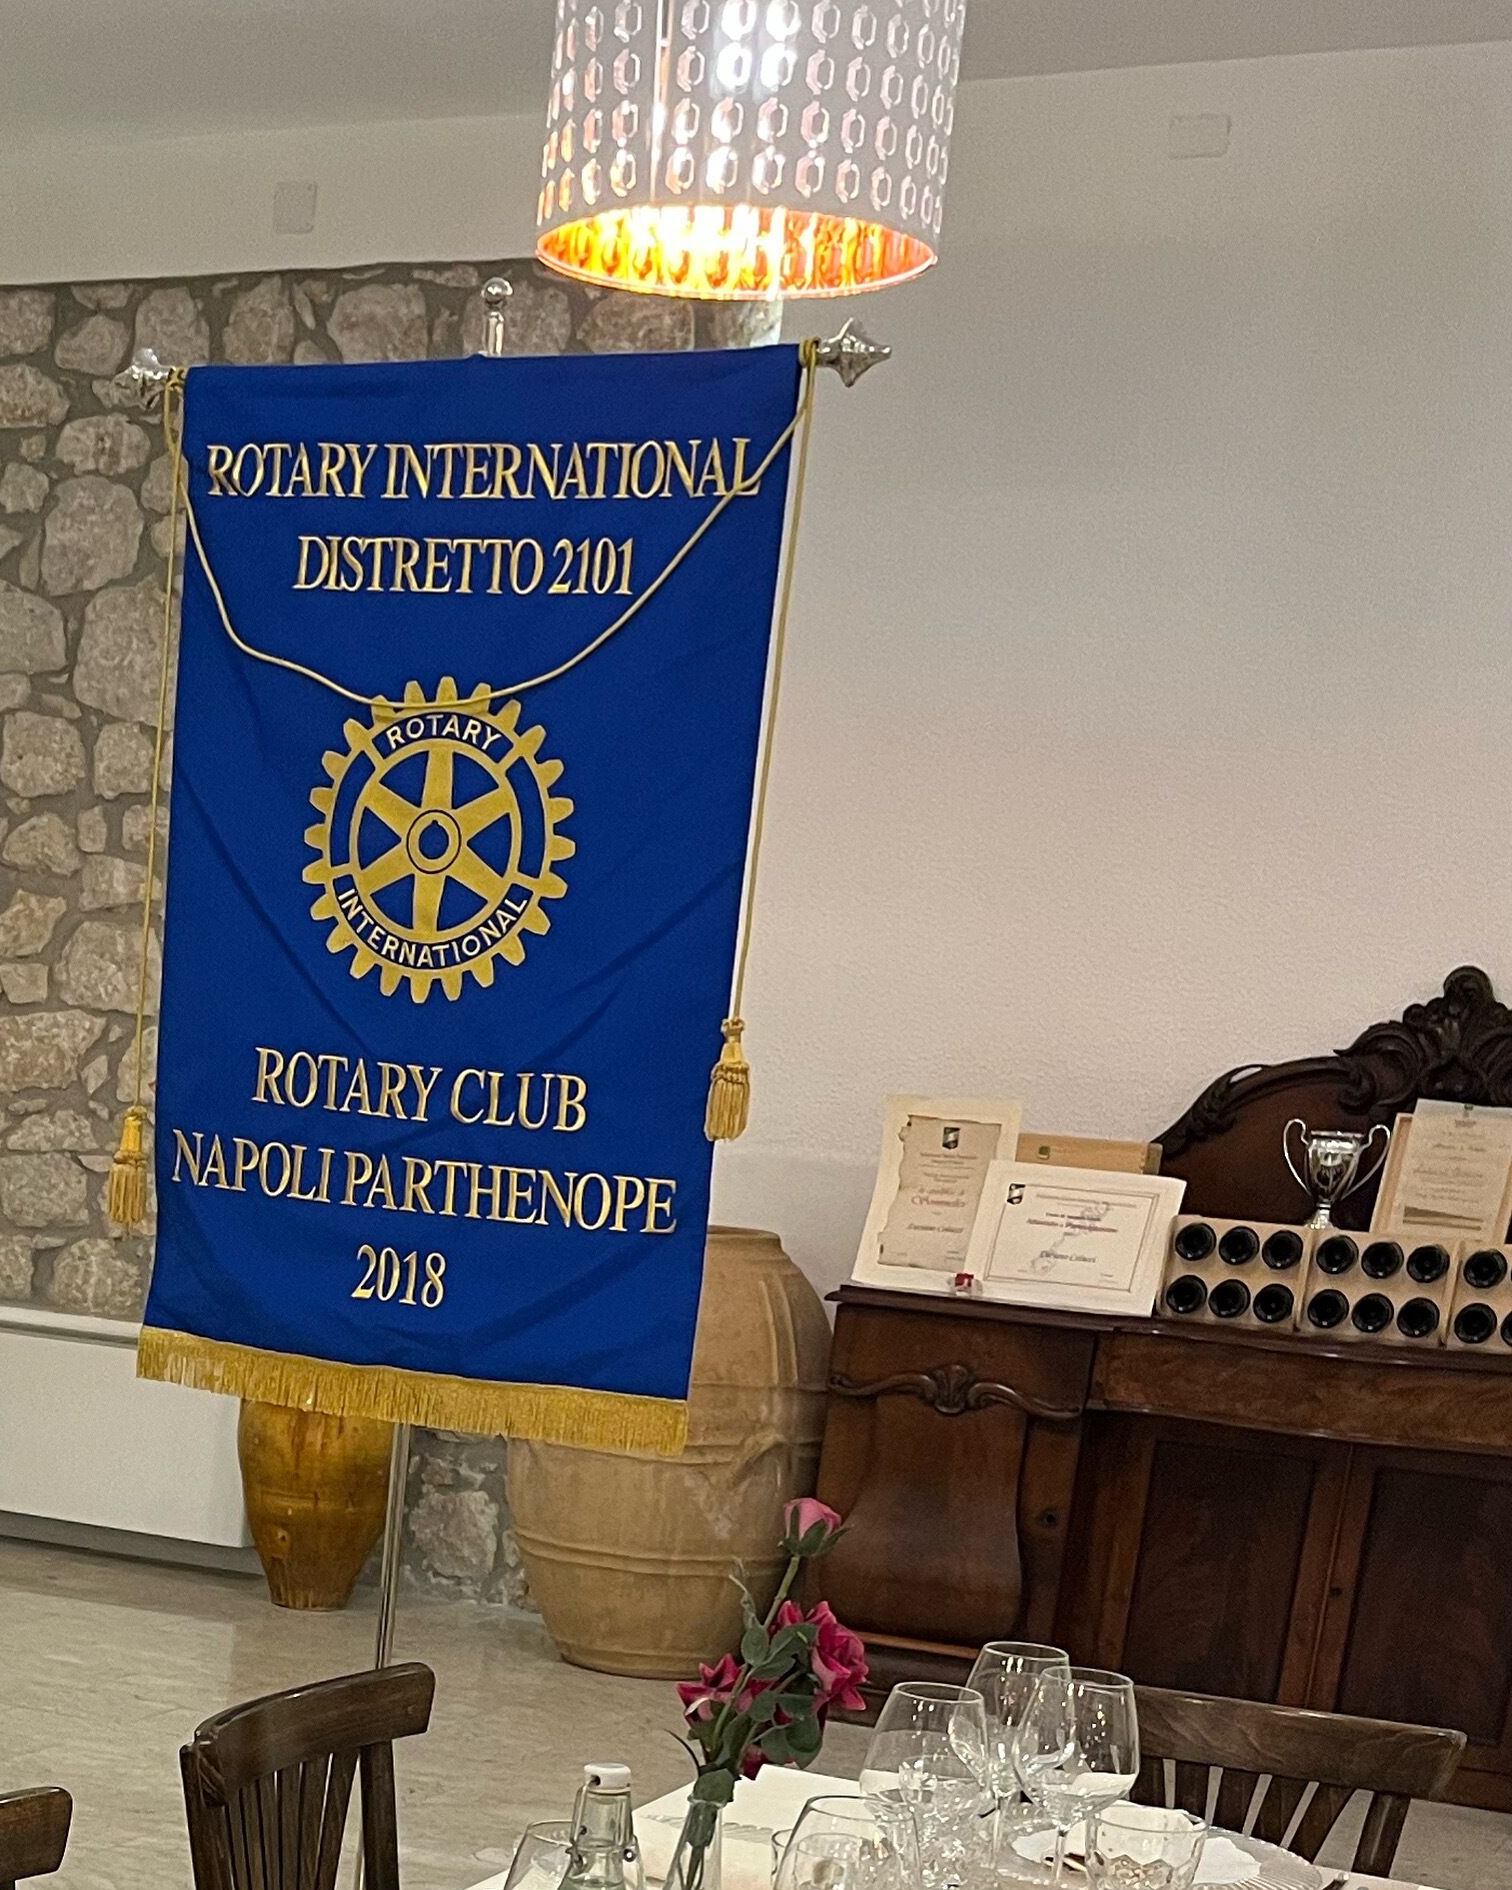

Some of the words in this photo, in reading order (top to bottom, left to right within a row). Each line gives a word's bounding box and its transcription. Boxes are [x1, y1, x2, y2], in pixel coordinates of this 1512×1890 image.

[206, 442, 376, 498] ROTARY
[380, 437, 762, 499] INTERNATIONAL
[292, 536, 544, 595] DISTRETTO
[547, 537, 635, 595] 2101
[386, 714, 501, 750] ROTARY
[338, 888, 528, 968] INTERNATIONAL
[252, 1046, 443, 1122] ROTARY
[449, 1068, 588, 1132] CLUB
[171, 1129, 334, 1204] NAPOLI
[340, 1150, 676, 1234] PARTHENOPE
[350, 1244, 447, 1308] 2018
